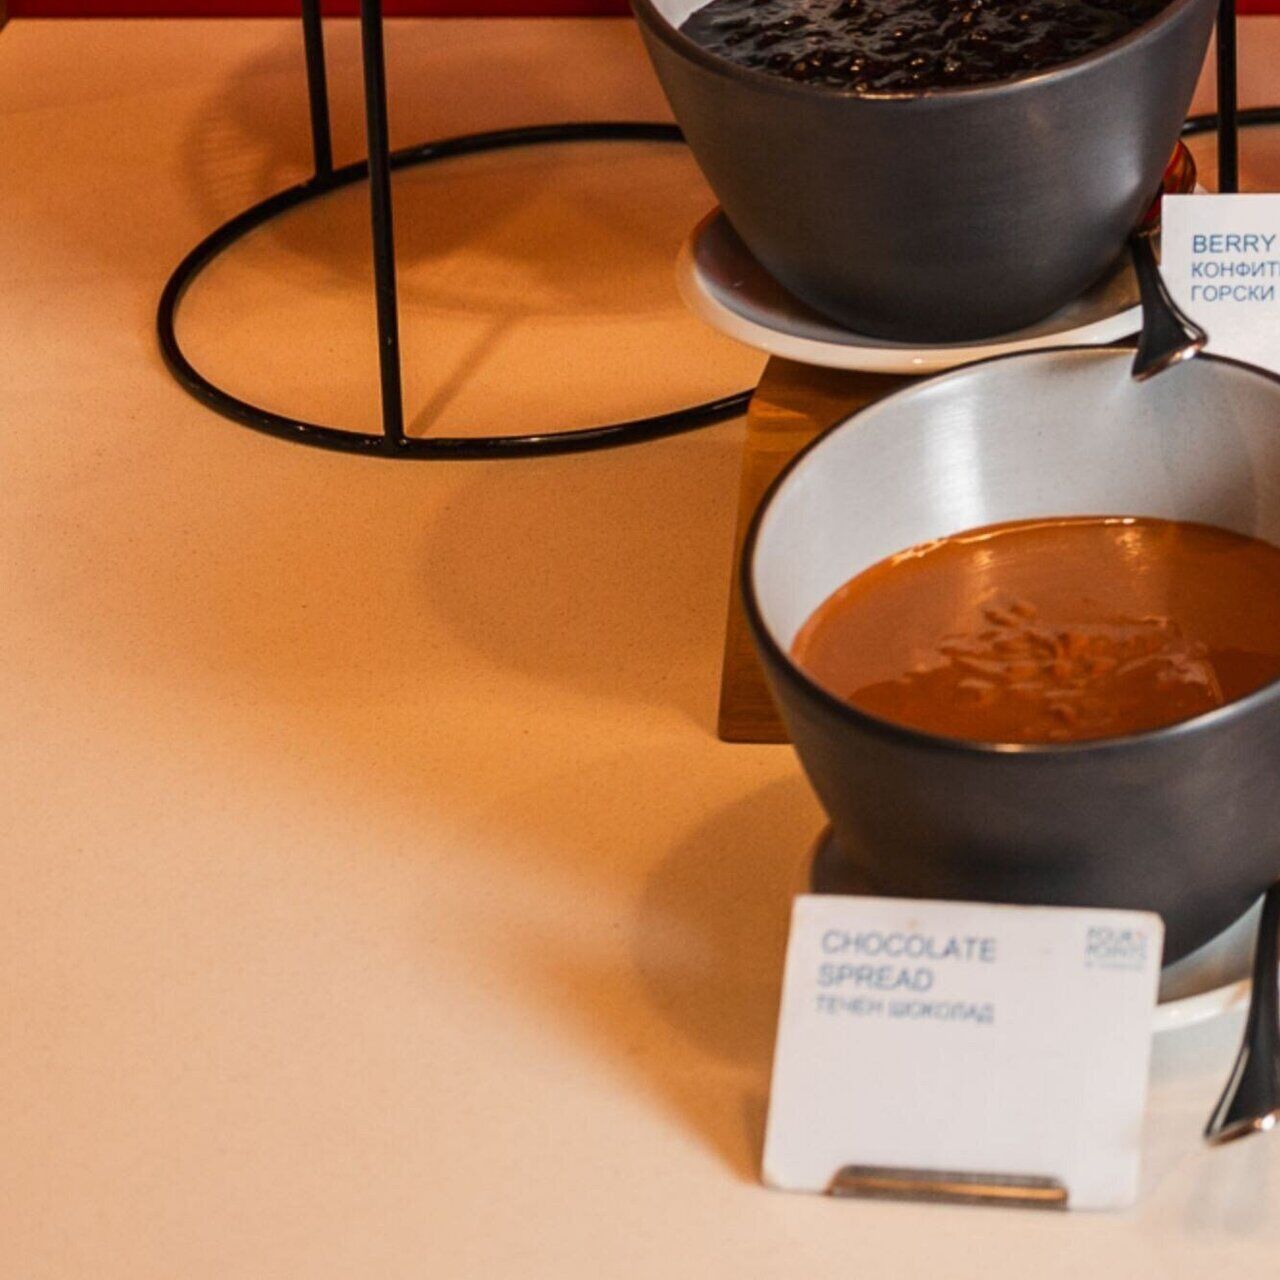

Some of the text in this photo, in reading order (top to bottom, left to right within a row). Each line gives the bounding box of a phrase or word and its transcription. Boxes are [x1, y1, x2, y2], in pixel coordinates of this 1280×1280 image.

[1192, 234, 1276, 253] BERRY
[1191, 285, 1275, 302] ГОРСКИ
[821, 929, 998, 963] CHOCOLATE
[817, 964, 934, 992] SPREAD
[816, 996, 995, 1024] ТЕЧЕН ШОКОЛАД
